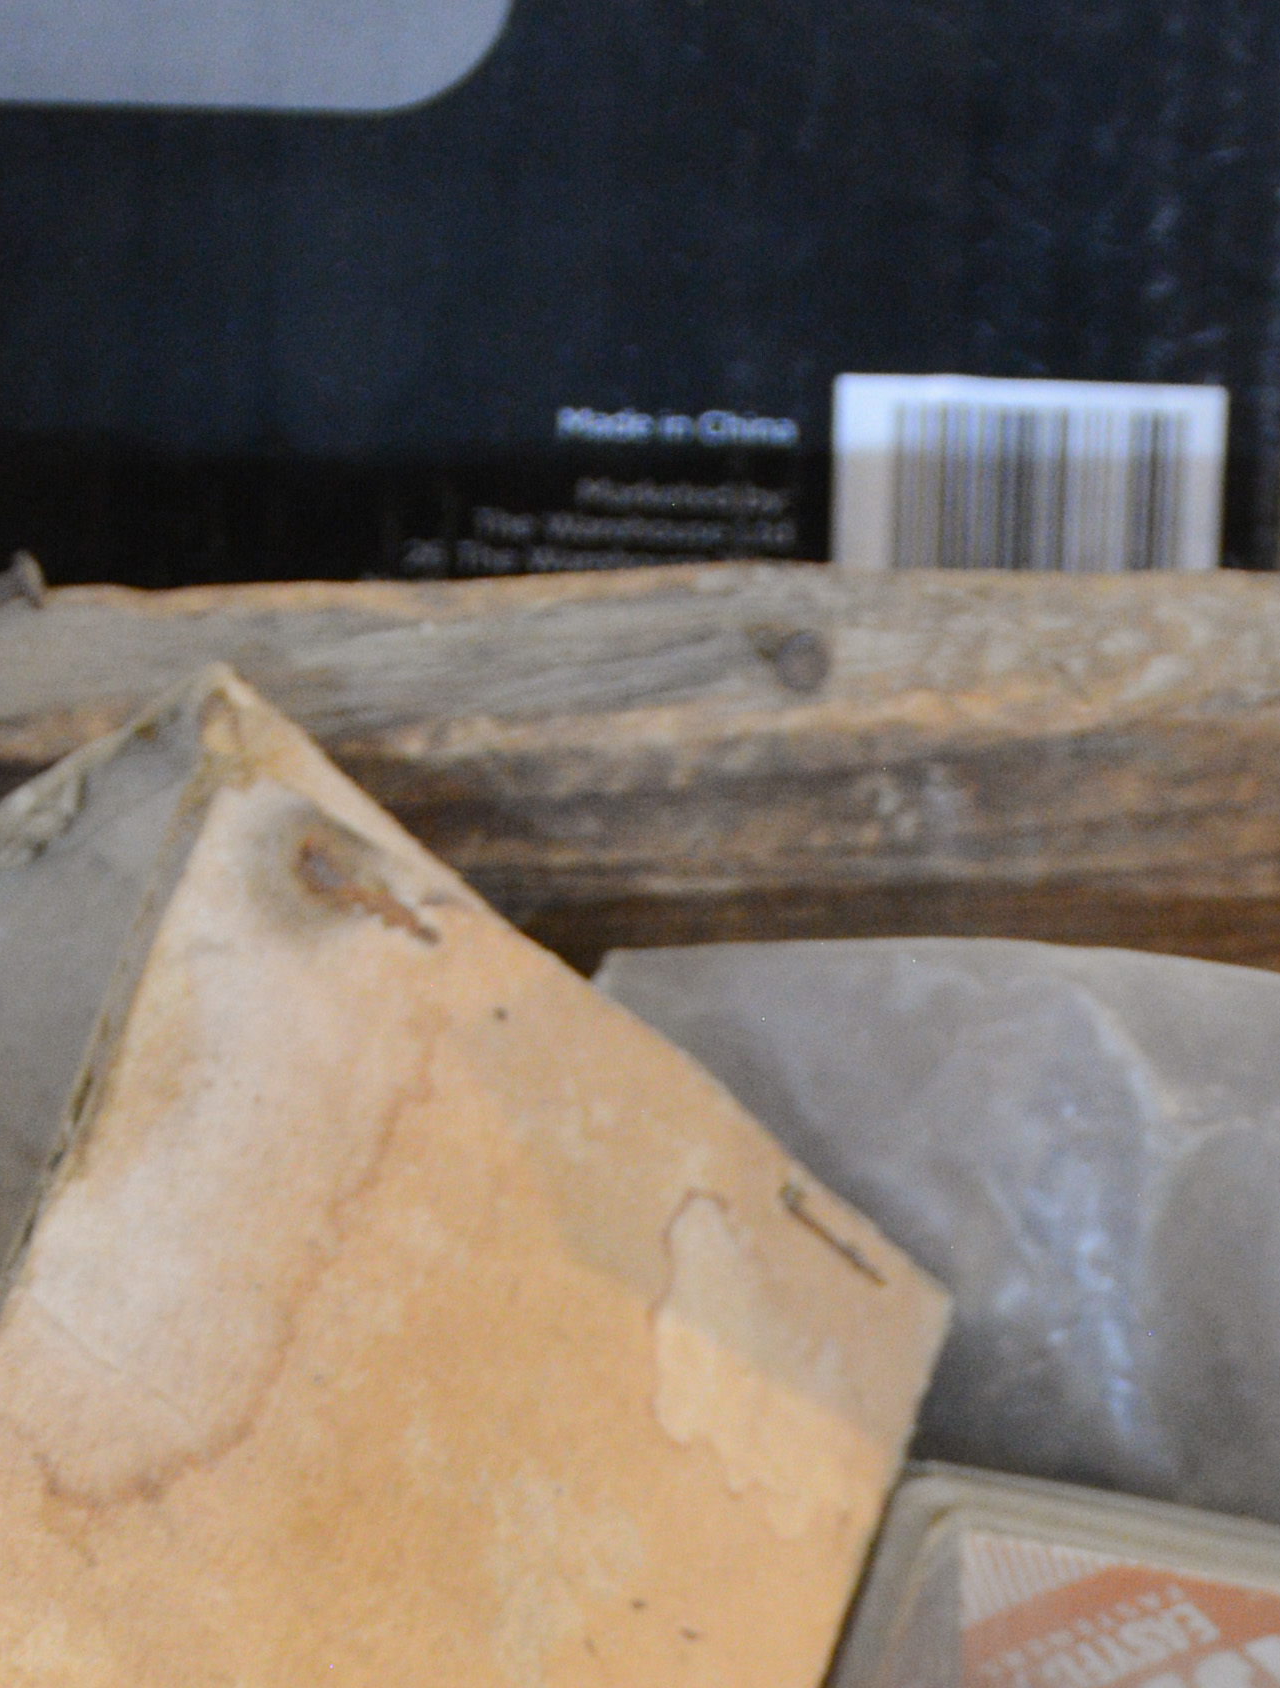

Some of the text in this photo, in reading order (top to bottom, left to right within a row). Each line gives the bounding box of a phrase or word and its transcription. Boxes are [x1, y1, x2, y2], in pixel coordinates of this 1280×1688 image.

[556, 406, 799, 448] Made in China
